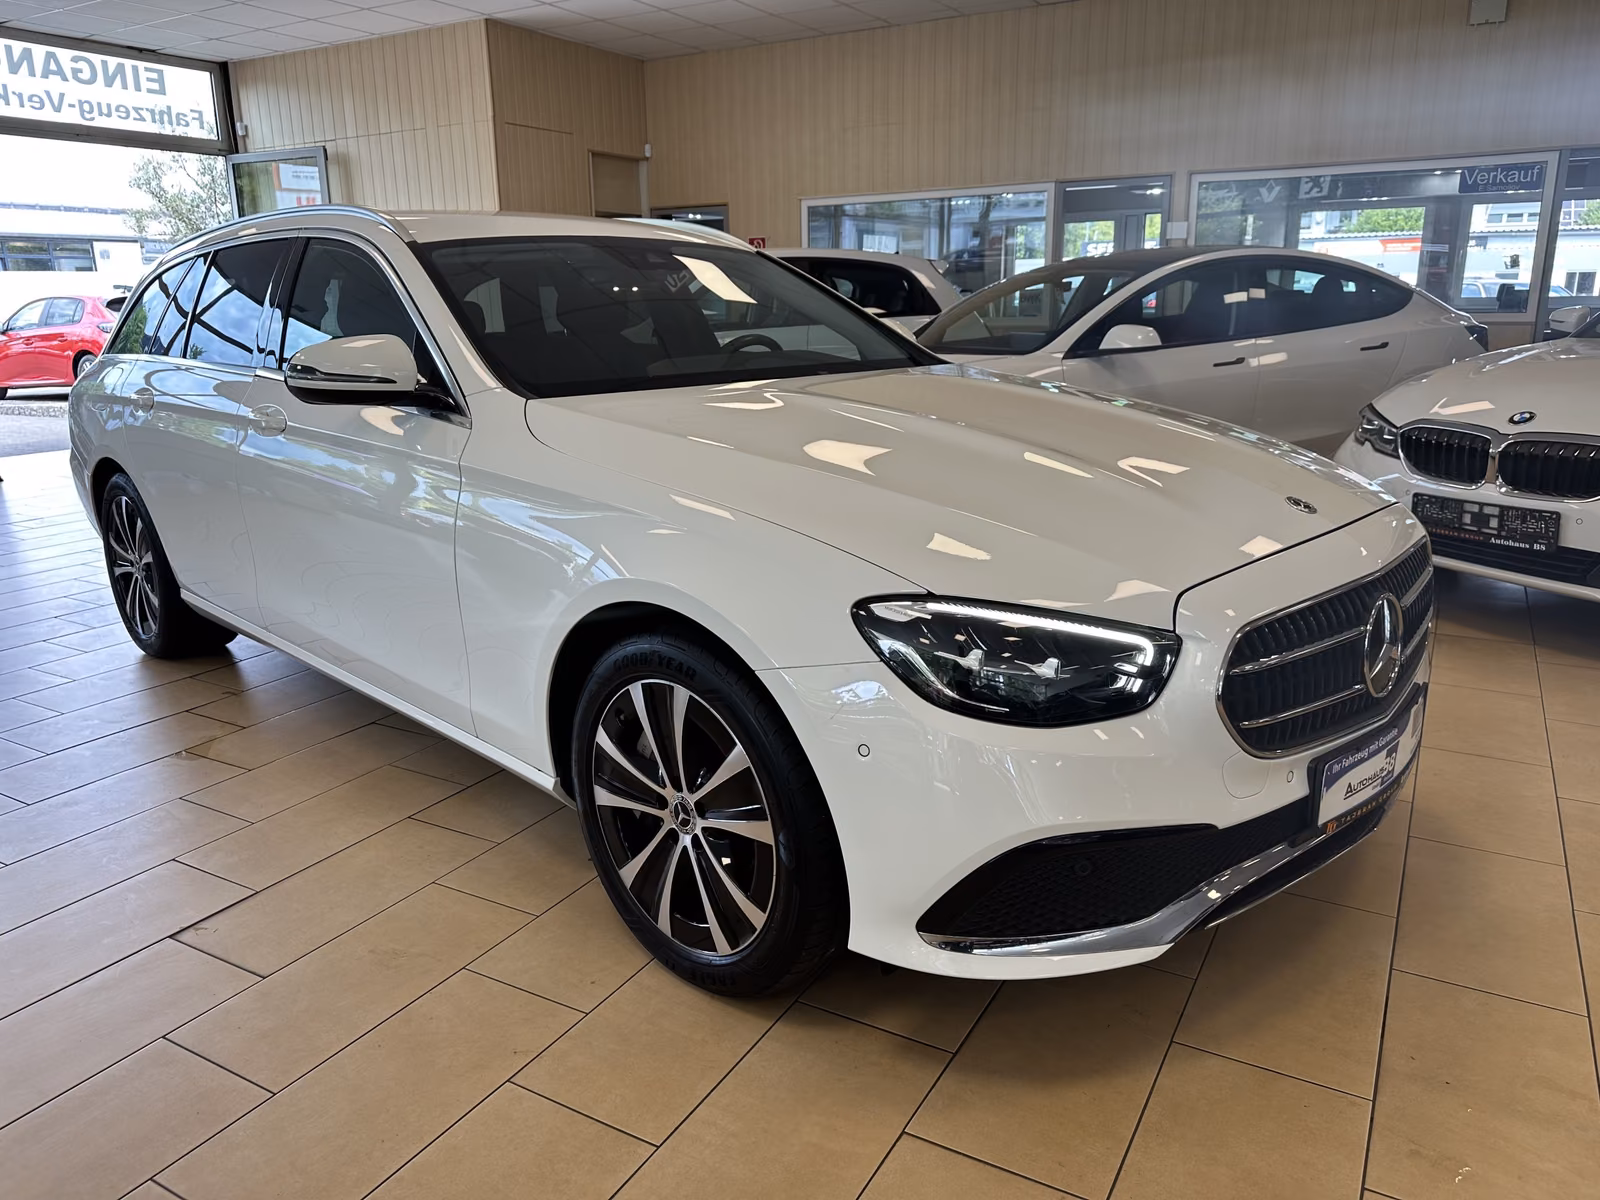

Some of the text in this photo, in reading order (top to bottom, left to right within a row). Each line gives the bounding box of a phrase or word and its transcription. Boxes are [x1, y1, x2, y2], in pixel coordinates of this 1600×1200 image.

[1464, 165, 1541, 185] Verkauf
[1489, 536, 1530, 549] Autohaus
[1332, 727, 1399, 775] Ihr Fahrzeug mit Garantie
